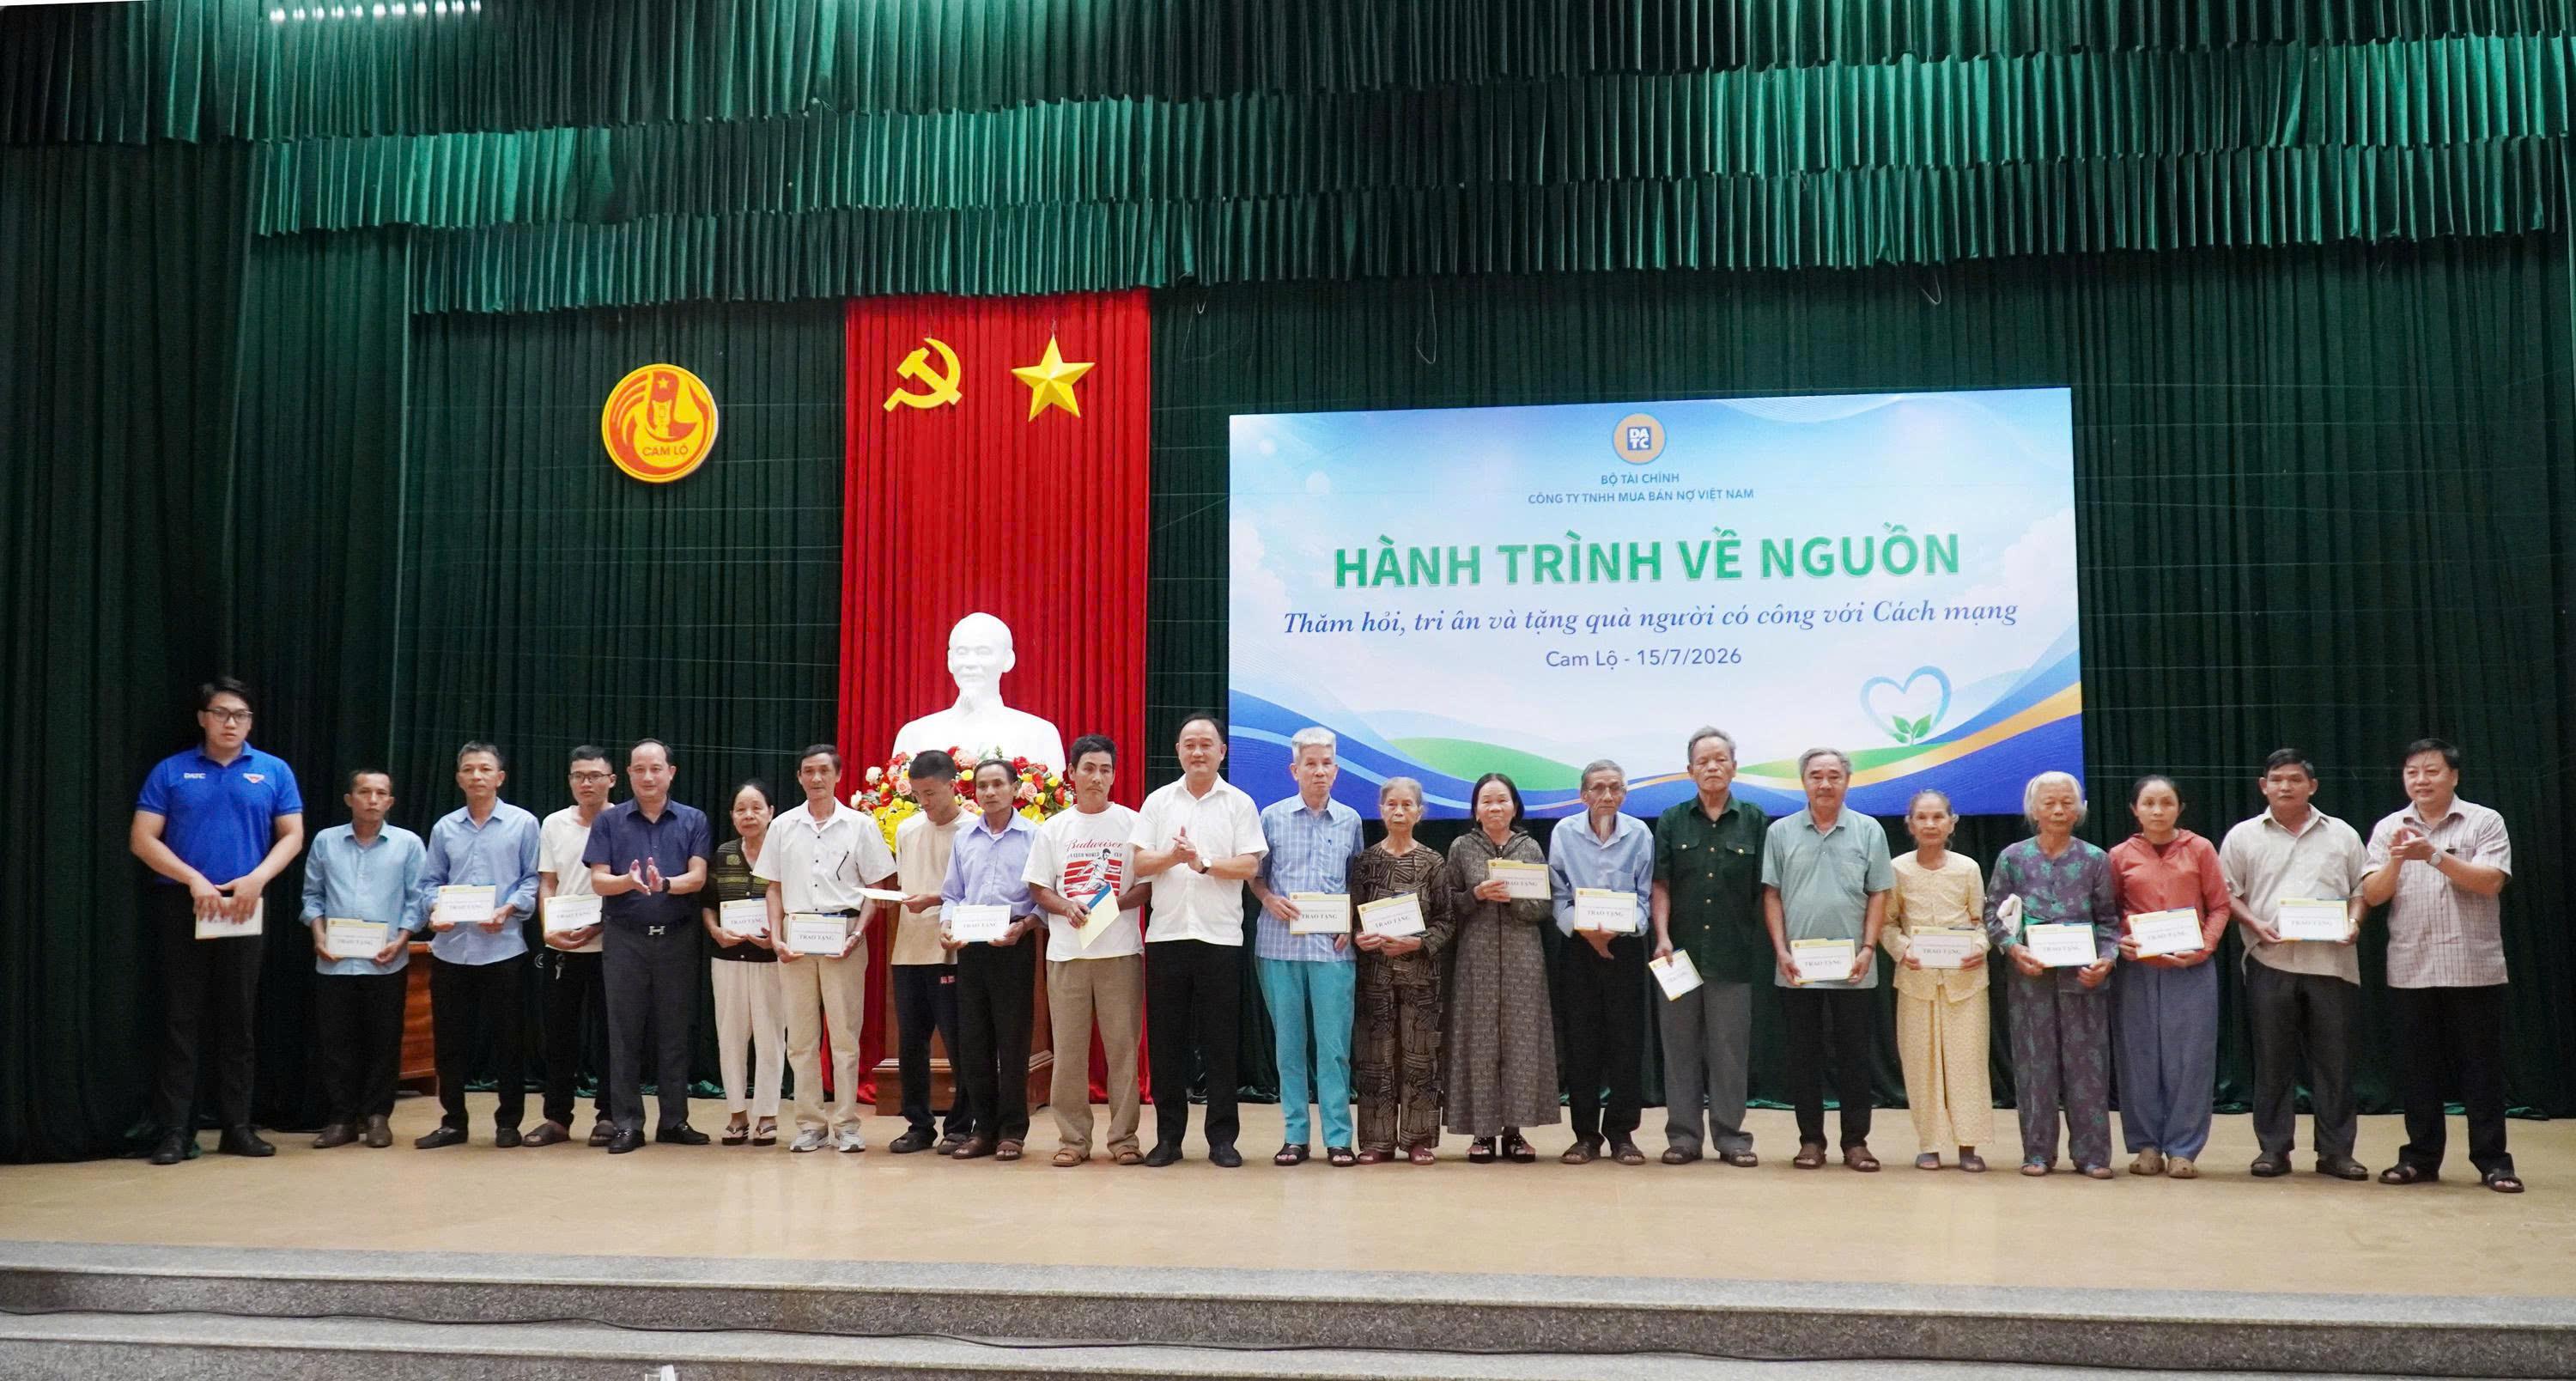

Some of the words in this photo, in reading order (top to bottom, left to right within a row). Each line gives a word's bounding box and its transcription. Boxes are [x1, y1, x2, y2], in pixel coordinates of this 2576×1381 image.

[1629, 428, 1649, 438] DA
[1630, 438, 1649, 448] TC
[642, 446, 671, 456] CAM
[1601, 474, 1618, 486] BỘ
[1621, 473, 1638, 485] TÀI
[1642, 472, 1680, 484] CHÍNH
[1528, 492, 1564, 504] CÔNG
[1566, 493, 1581, 503] TY
[1583, 493, 1614, 502] TNHH
[1619, 492, 1645, 502] MUA
[1649, 490, 1673, 501] BÁN
[1677, 490, 1696, 502] NỢ
[1698, 489, 1723, 502] VIỆT
[1726, 489, 1754, 499] NAM
[1335, 534, 1481, 588] HÀNH
[1497, 529, 1662, 585] TRÌNH
[1676, 526, 1742, 581] VỀ
[1760, 522, 1959, 579] NGUỒN
[1283, 611, 1354, 634] Thăm
[1362, 611, 1406, 636] hỏi,
[1415, 610, 1444, 631] tri
[1451, 611, 1481, 630] ân
[1489, 612, 1517, 630] và
[1525, 611, 1577, 635] tặng
[1585, 608, 1632, 635] quà
[1639, 605, 1716, 633] người
[1722, 605, 1748, 625] có
[1757, 604, 1816, 630] công
[1824, 601, 1865, 623] với
[1874, 599, 1935, 623] Cách
[1944, 604, 2019, 626] mạng
[1546, 650, 1589, 667] Cam
[1596, 650, 1619, 670] Lộ
[1637, 648, 1742, 666] 15/7/2026
[1065, 838, 1123, 851] Budweiser
